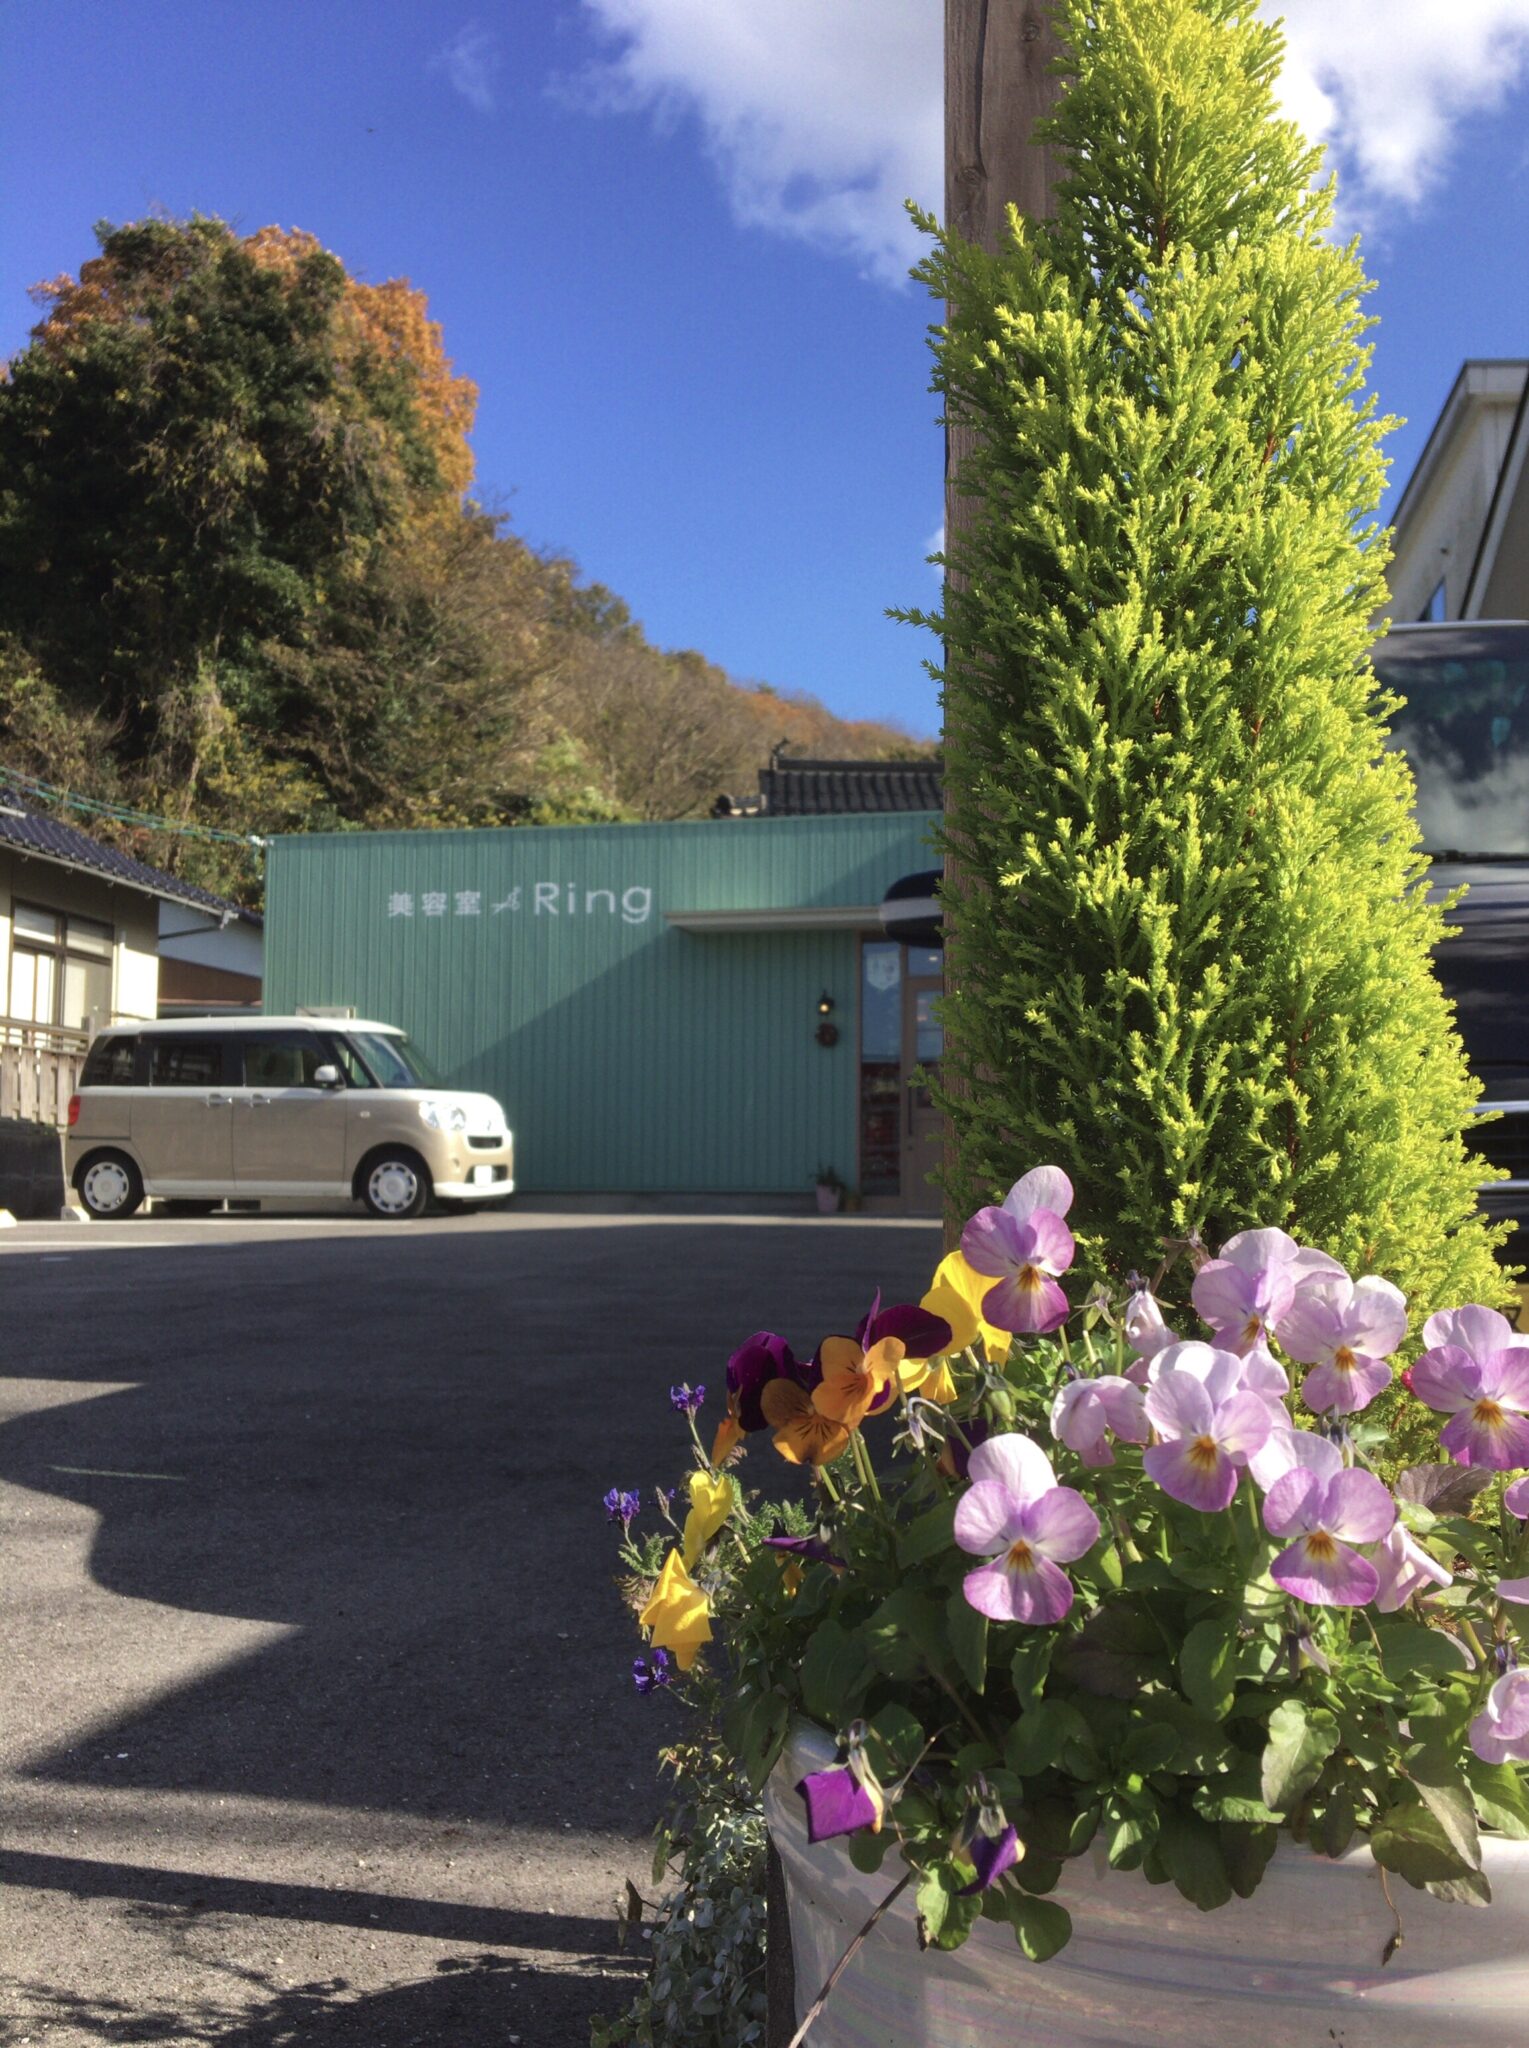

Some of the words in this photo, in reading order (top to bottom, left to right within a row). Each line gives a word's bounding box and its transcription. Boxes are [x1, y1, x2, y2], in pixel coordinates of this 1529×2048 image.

[388, 890, 481, 917] 美容室
[534, 881, 652, 924] Ring
